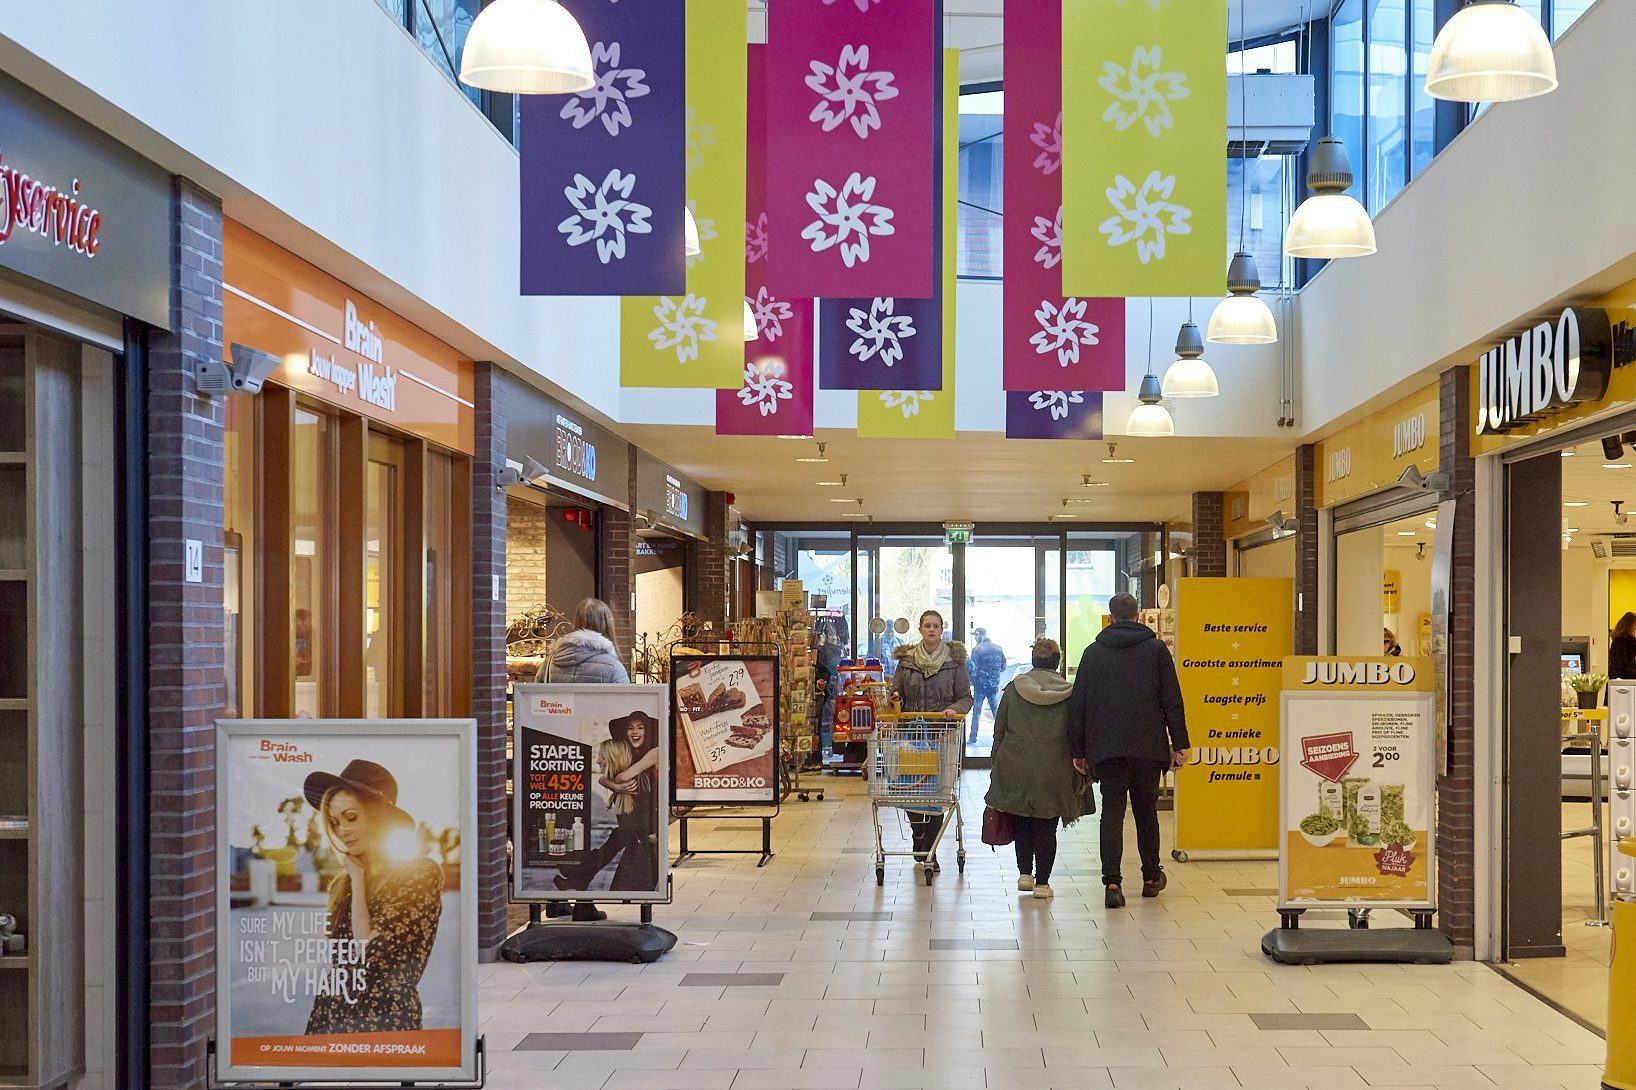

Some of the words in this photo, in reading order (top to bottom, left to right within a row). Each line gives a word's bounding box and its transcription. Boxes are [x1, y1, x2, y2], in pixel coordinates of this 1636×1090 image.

[344, 299, 383, 364] Brain
[1475, 307, 1581, 436] JUMBO
[357, 362, 397, 411] Wash
[1393, 413, 1426, 459] JUMBO
[1328, 447, 1352, 484] JUMBO
[1204, 623, 1231, 633] Beste
[1233, 623, 1267, 633] service
[1182, 658, 1226, 669] Grootste
[1228, 659, 1283, 669] assortimen
[1302, 662, 1416, 686] JUMBO
[540, 700, 563, 708] Brain
[1204, 694, 1243, 706] Laagste
[1244, 694, 1266, 706] prijs
[1208, 729, 1223, 739] De
[1225, 729, 1261, 739] unieke
[261, 740, 297, 751] Brain
[1307, 741, 1350, 756] SEIZOENS
[273, 752, 313, 763] Wash
[530, 745, 584, 760] STAPEL
[1188, 746, 1280, 766] JUMBO
[530, 760, 584, 772] KORTING
[530, 774, 545, 782] TOT
[548, 774, 585, 791] 45%
[1209, 771, 1252, 784] formule
[530, 782, 547, 790] WEL
[530, 792, 541, 800] OP
[559, 793, 584, 801] KEUNE
[529, 800, 584, 810] PRODUCTEN
[1381, 850, 1407, 864] Pluk
[1339, 876, 1377, 885] JUMBO
[240, 916, 267, 934] SURE
[272, 911, 298, 941] MY
[301, 912, 332, 935] LIFE
[294, 938, 371, 968] PERFECT,
[247, 967, 268, 983] BUT
[271, 958, 300, 1004] MY
[305, 967, 359, 1005] HAIR
[352, 968, 367, 992] IS
[260, 1044, 272, 1053] OP
[272, 1044, 294, 1053] JOUW
[295, 1045, 328, 1053] MOMENT
[329, 1043, 371, 1054] ZONDER
[373, 1043, 426, 1055] AFSPRAAK
